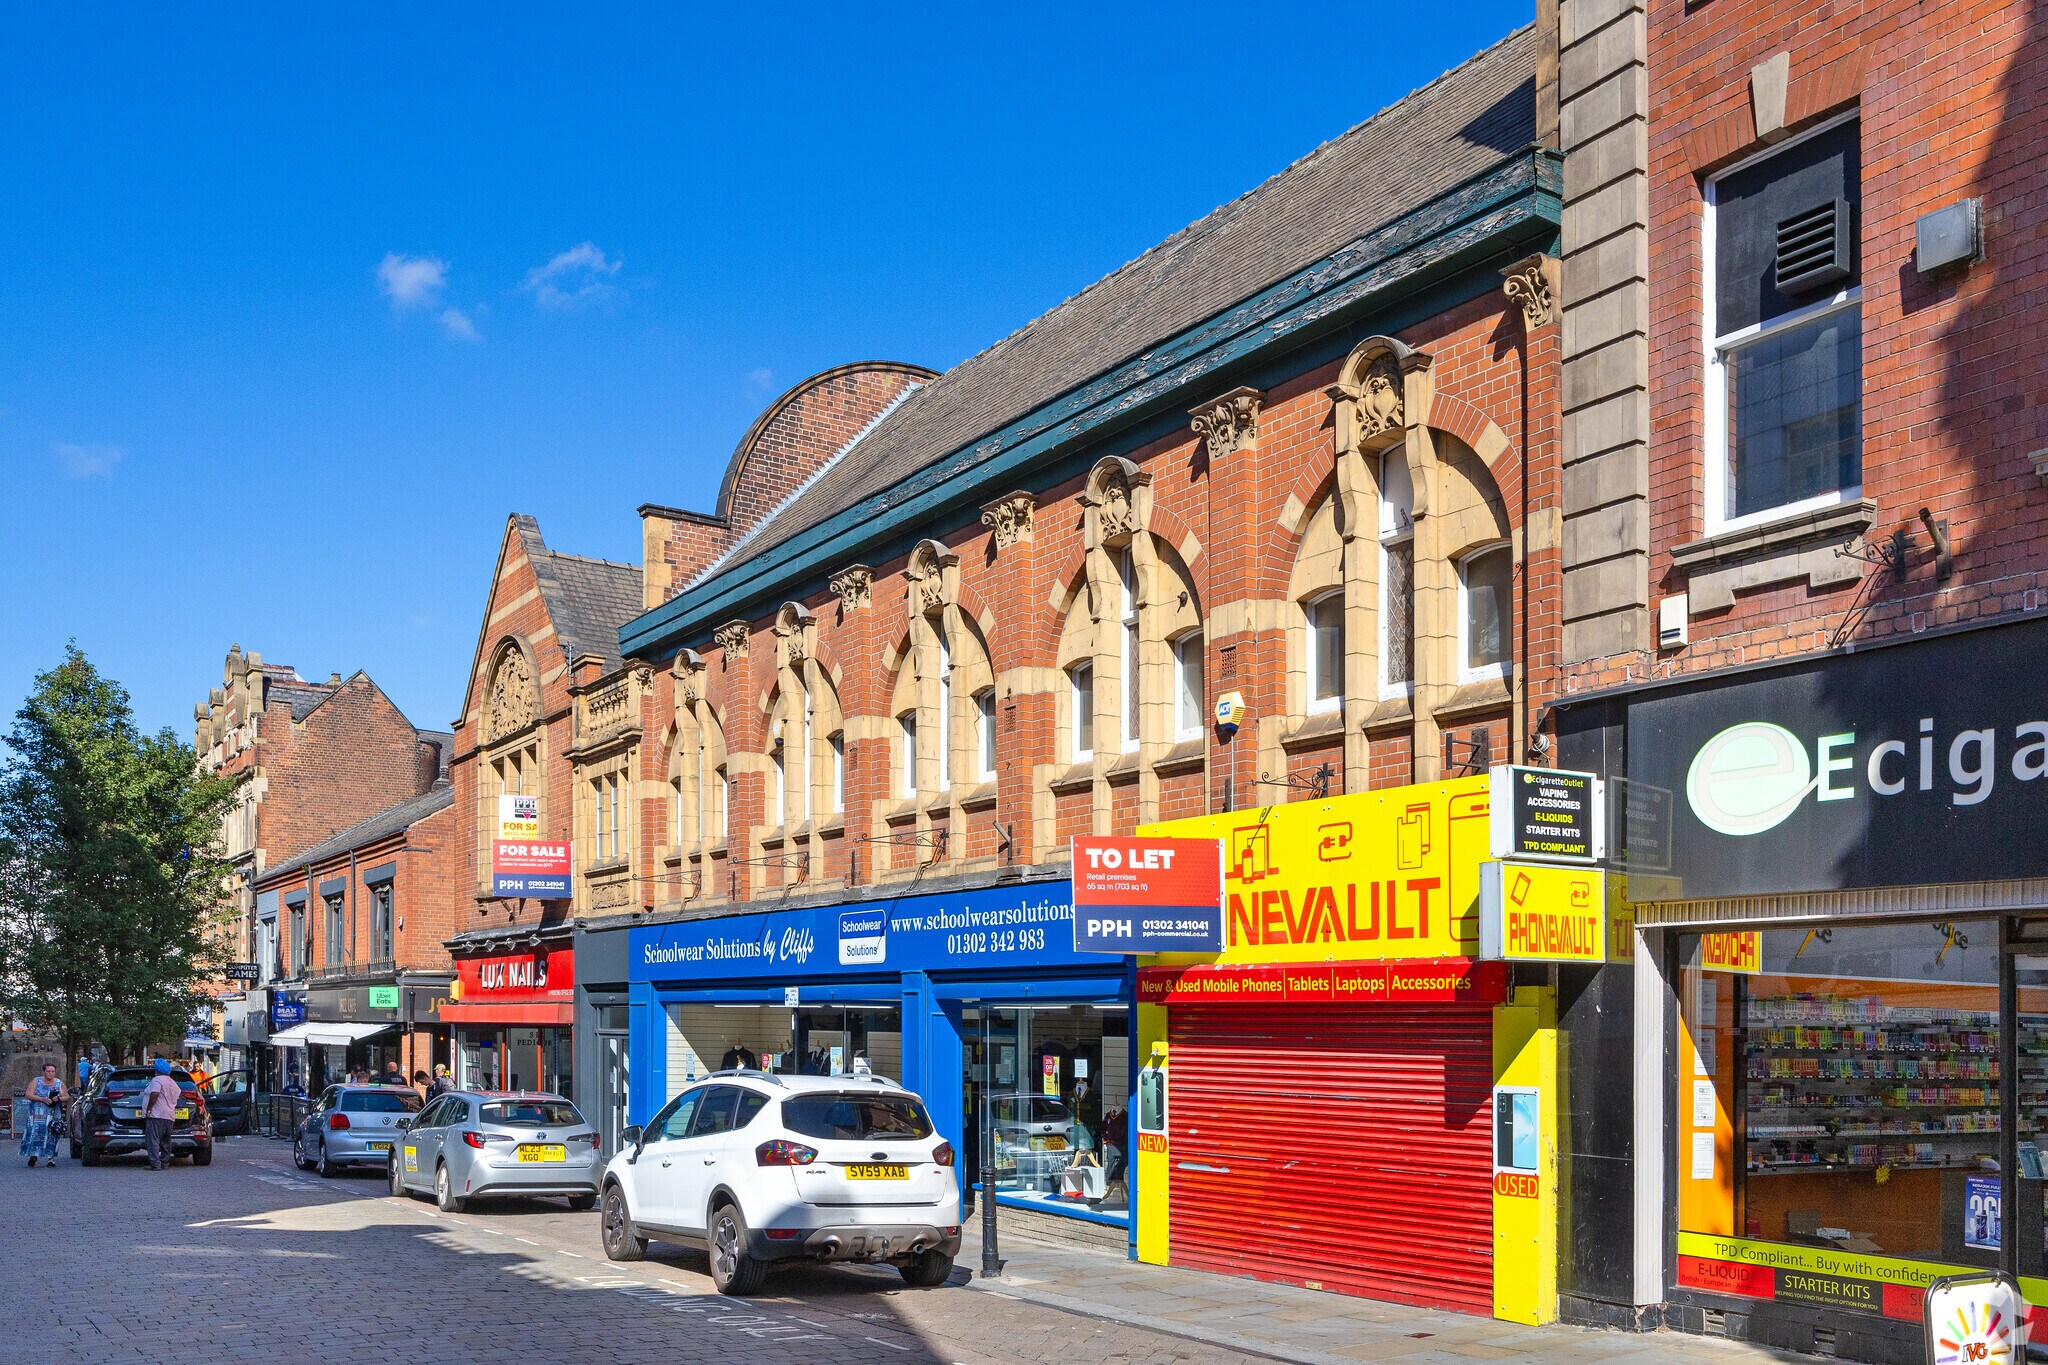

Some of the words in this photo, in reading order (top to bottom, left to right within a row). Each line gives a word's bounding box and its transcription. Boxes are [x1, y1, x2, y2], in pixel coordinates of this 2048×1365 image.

[1539, 787, 1569, 799] VAPING
[1527, 796, 1581, 810] ACCESSORIES
[503, 822, 523, 831] FOR
[1535, 811, 1573, 824] E-LIQUIDS
[1526, 825, 1560, 836] STARTER
[1562, 827, 1580, 838] KITS
[500, 845, 528, 856] FOR
[530, 845, 565, 857] SALE
[1524, 841, 1539, 851] TPD
[1540, 842, 1585, 854] COMPLIANT
[1086, 848, 1122, 869] TO
[1129, 848, 1175, 869] LET
[500, 879, 524, 890] PPH
[1106, 873, 1137, 882] premises
[1115, 882, 1130, 891] (703
[1140, 883, 1148, 892] ft)
[891, 899, 1075, 933] www.schoolwearsolutions
[1226, 876, 1441, 947] NEVAULT
[842, 918, 882, 933] Schoolwear
[1087, 919, 1132, 938] PPH
[1142, 920, 1173, 930] 01302
[1175, 920, 1209, 930] 341041
[1509, 912, 1597, 956] PHONEVAULT
[644, 942, 704, 964] Schoolwear
[706, 937, 761, 961] Solutions
[763, 929, 776, 965] by
[779, 926, 815, 965] Cliffs
[948, 932, 986, 955] 01302
[990, 930, 1015, 952] 342
[1019, 928, 1045, 951] 983
[846, 945, 877, 957] Solutions
[228, 970, 258, 978] GAMES
[481, 963, 504, 989] LUX
[509, 959, 547, 988] NAILS
[1141, 979, 1163, 993] New
[1165, 978, 1174, 993] &
[1175, 978, 1200, 993] Used
[1203, 977, 1239, 993] Mobile
[1242, 977, 1282, 993] Phones
[1287, 976, 1330, 992] Tablets
[1335, 975, 1385, 995] Laptops
[1392, 973, 1471, 991] Accessories
[1139, 1134, 1165, 1152] NEW
[850, 1165, 881, 1177] SV59
[884, 1165, 905, 1178] XAB
[1498, 1174, 1538, 1198] USED
[1698, 1262, 1750, 1282] E-LIQUID
[1714, 1242, 1738, 1257] TPD
[1740, 1246, 1813, 1268] Compliant...
[1816, 1255, 1840, 1274] Buy
[1843, 1260, 1872, 1276] with
[1876, 1266, 1940, 1284] confiden
[1681, 1274, 1699, 1284] British
[1703, 1277, 1731, 1289] European
[1736, 1281, 1765, 1293] American
[1785, 1274, 1840, 1296] STARTER
[1843, 1283, 1871, 1300] KITS
[1775, 1290, 1794, 1298] HELPING
[1839, 1299, 1857, 1307] OPTION
[1857, 1301, 1868, 1309] FOR
[1962, 1342, 1989, 1363] IVG
